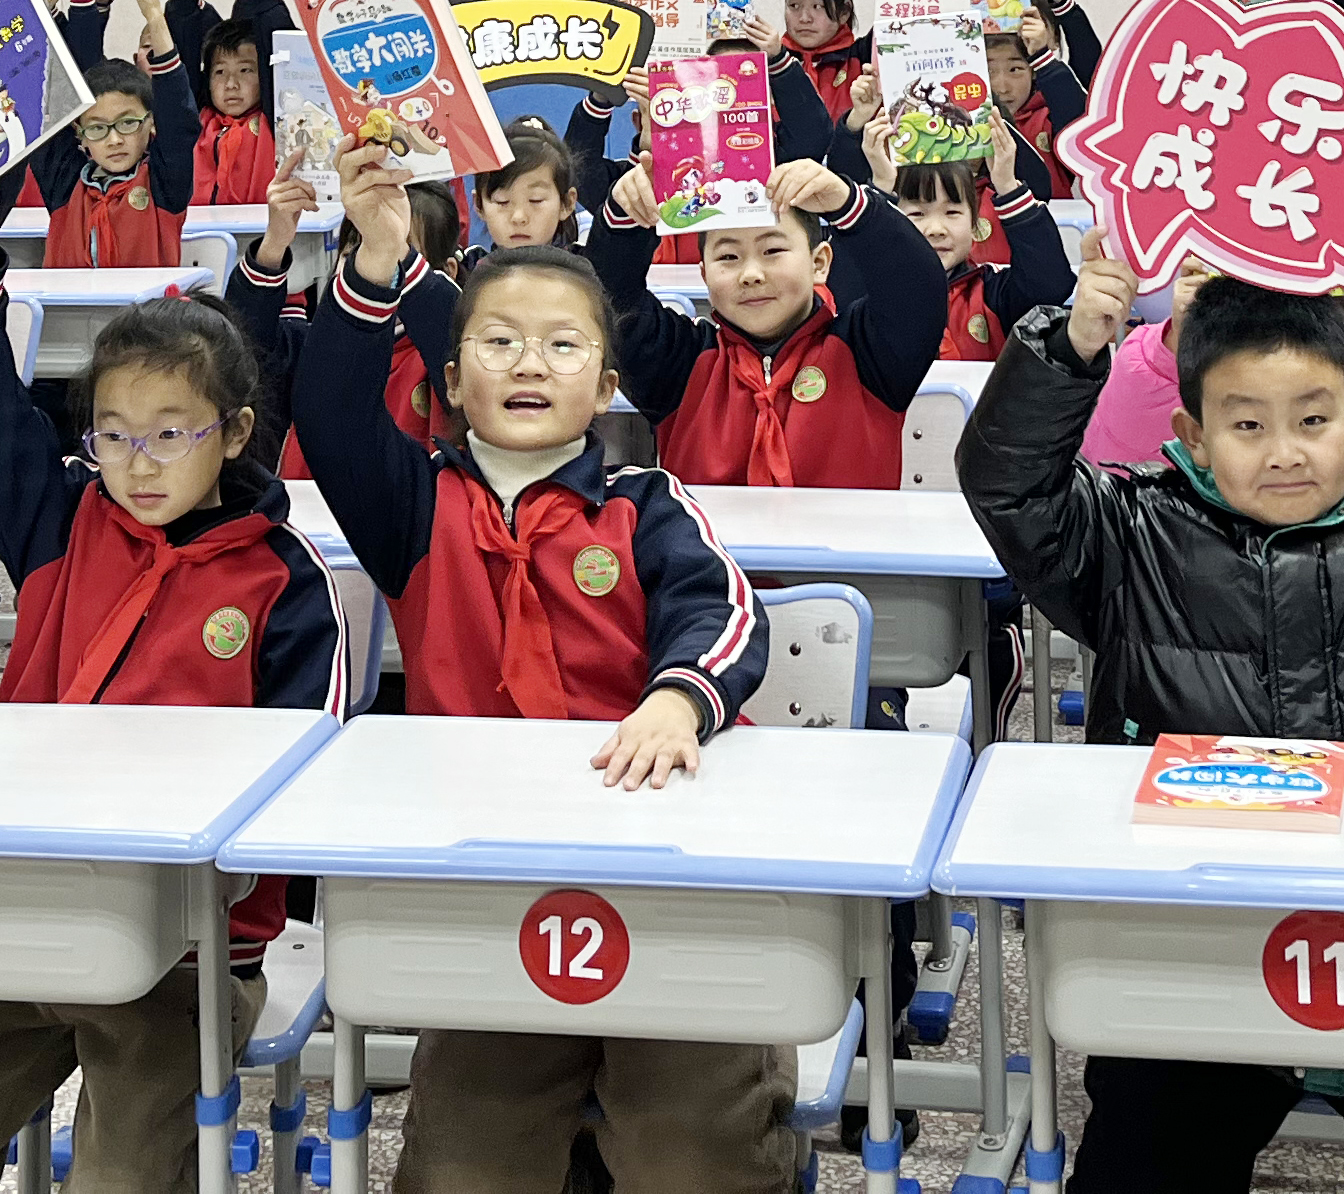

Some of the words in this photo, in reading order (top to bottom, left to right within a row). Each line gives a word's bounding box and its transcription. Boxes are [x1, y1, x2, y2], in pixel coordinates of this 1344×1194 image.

[332, 29, 433, 74] 数学大闯关
[458, 14, 604, 69] 康成长
[953, 83, 982, 100] 昆虫
[1131, 123, 1320, 241] 成长
[538, 915, 605, 980] 12
